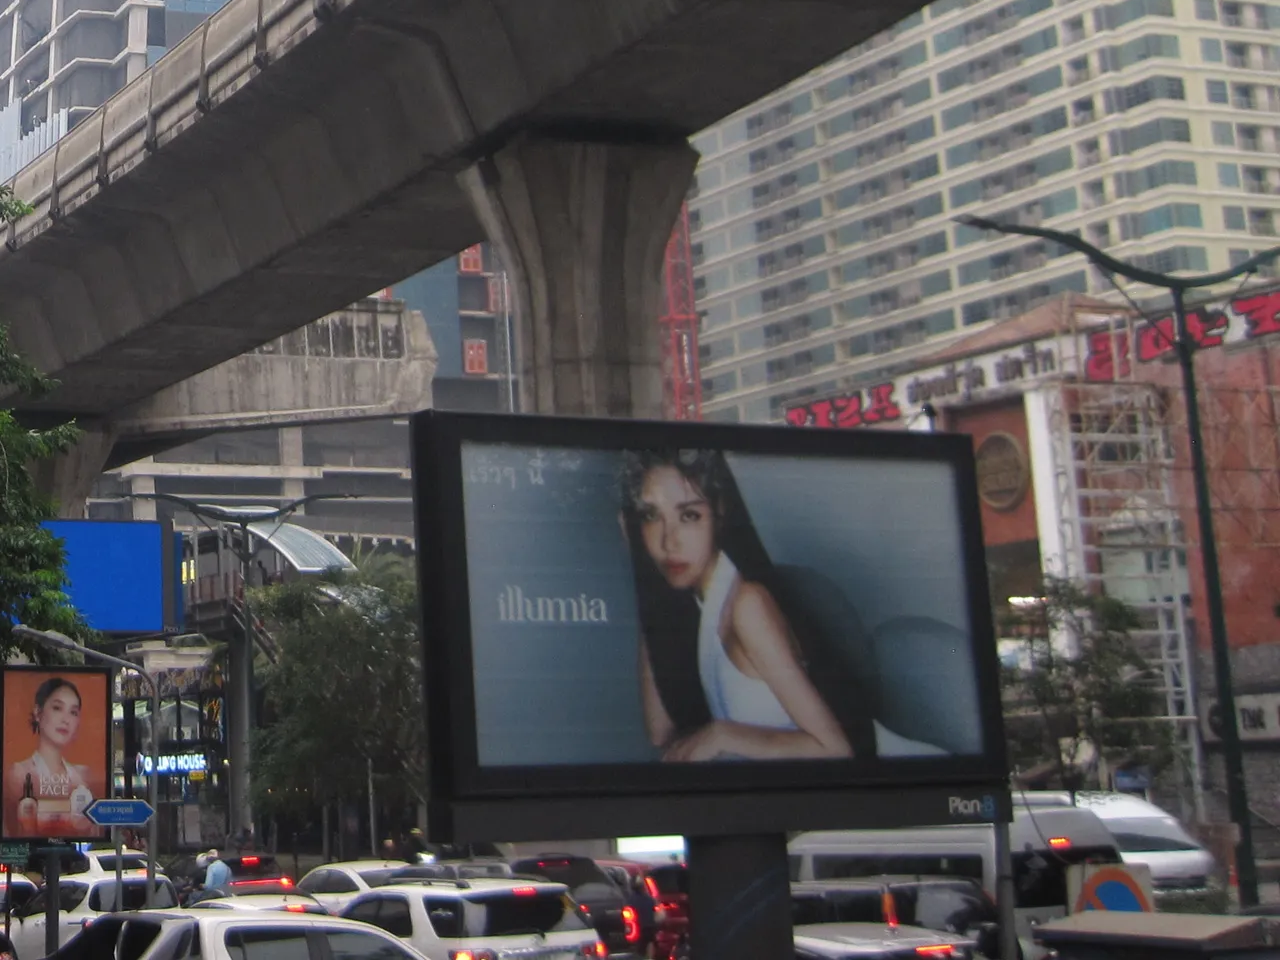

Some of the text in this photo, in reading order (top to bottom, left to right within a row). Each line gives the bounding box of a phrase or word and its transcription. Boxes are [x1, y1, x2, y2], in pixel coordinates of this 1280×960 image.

[498, 585, 608, 623] illumia
[177, 753, 205, 769] HOUSE
[40, 784, 70, 796] FACE
[948, 795, 979, 814] Plan
